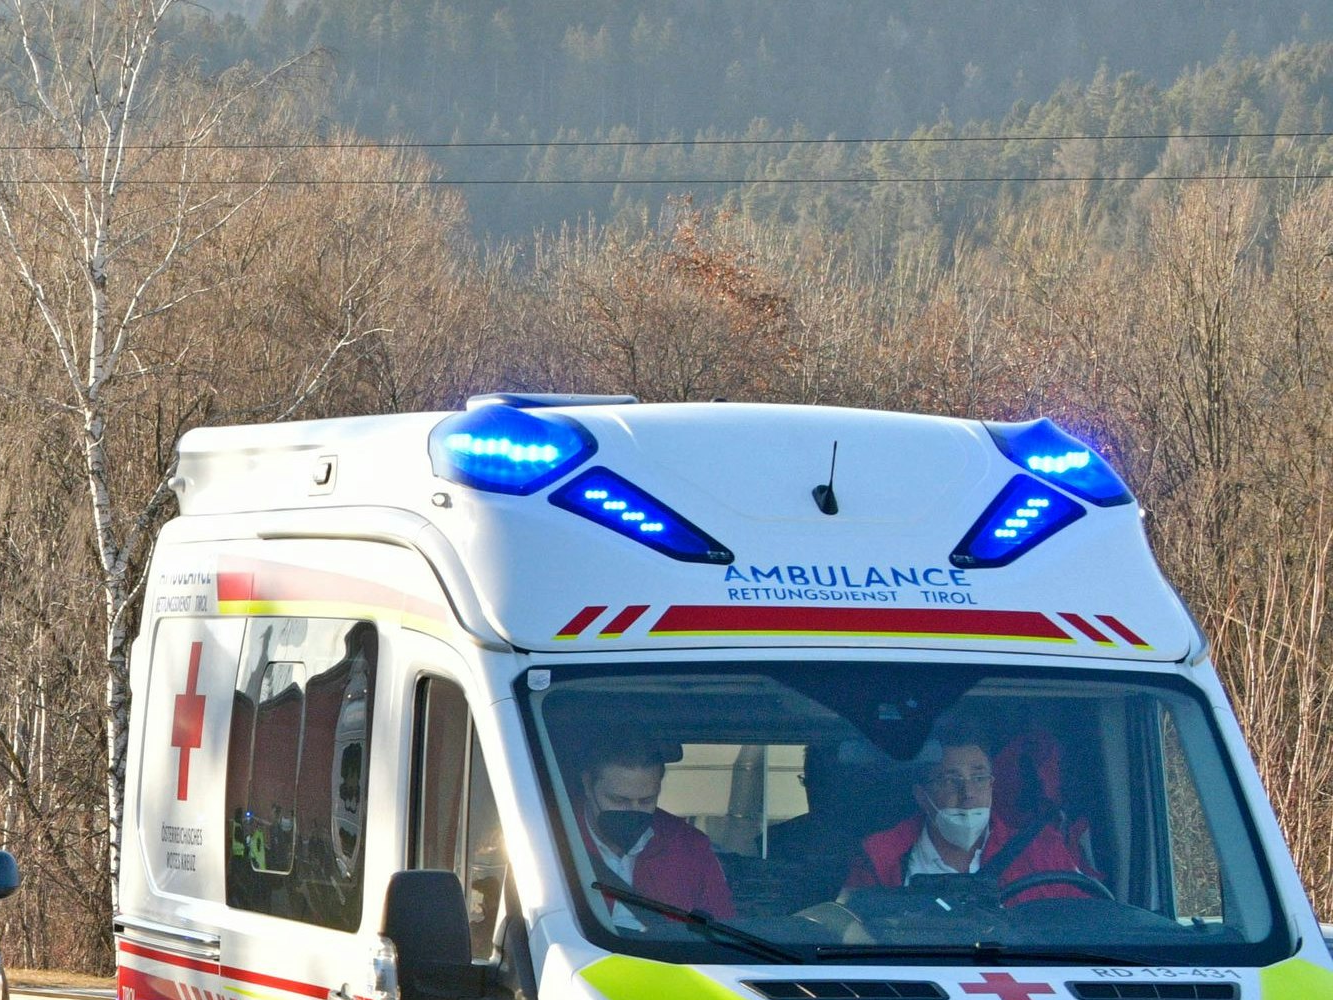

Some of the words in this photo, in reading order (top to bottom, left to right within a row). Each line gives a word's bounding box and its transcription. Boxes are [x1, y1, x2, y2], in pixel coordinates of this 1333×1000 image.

[724, 565, 972, 588] AMBULANCE
[727, 588, 898, 602] RETTUNGSDIENST
[920, 590, 978, 605] TIROL
[1090, 968, 1133, 978] RD
[1141, 967, 1242, 979] 13-431
